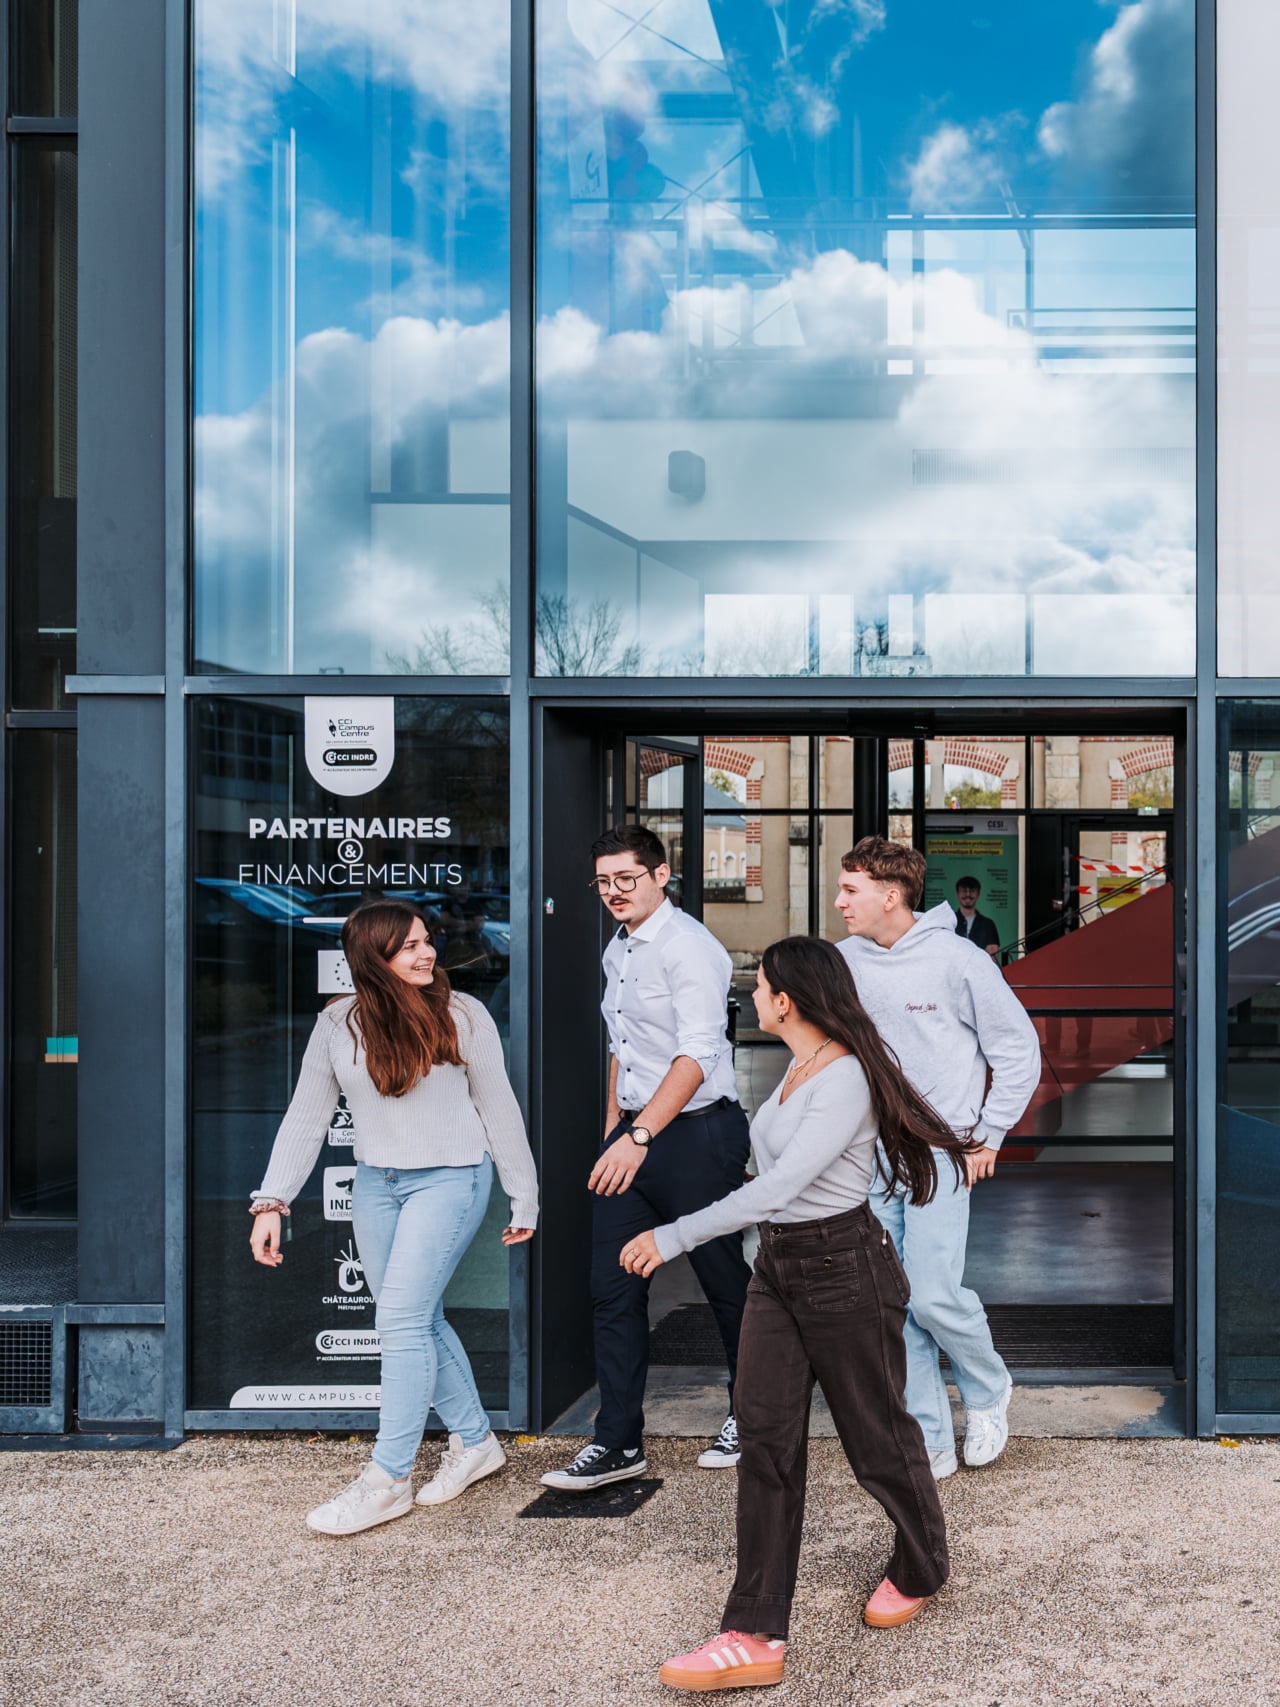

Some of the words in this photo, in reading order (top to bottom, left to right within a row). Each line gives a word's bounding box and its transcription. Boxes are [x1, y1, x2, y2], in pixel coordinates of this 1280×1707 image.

[338, 724, 375, 736] Campus
[336, 753, 350, 761] CCI
[351, 753, 374, 761] INDRE
[249, 817, 451, 839] PARTENAIRES
[239, 863, 463, 885] FINANCEMENTS
[330, 1199, 352, 1210] IND
[322, 1295, 377, 1304] CHÂTEAUROU
[335, 1338, 351, 1346] CCI
[255, 1392, 381, 1401] WWW.CAMPUS-CE
